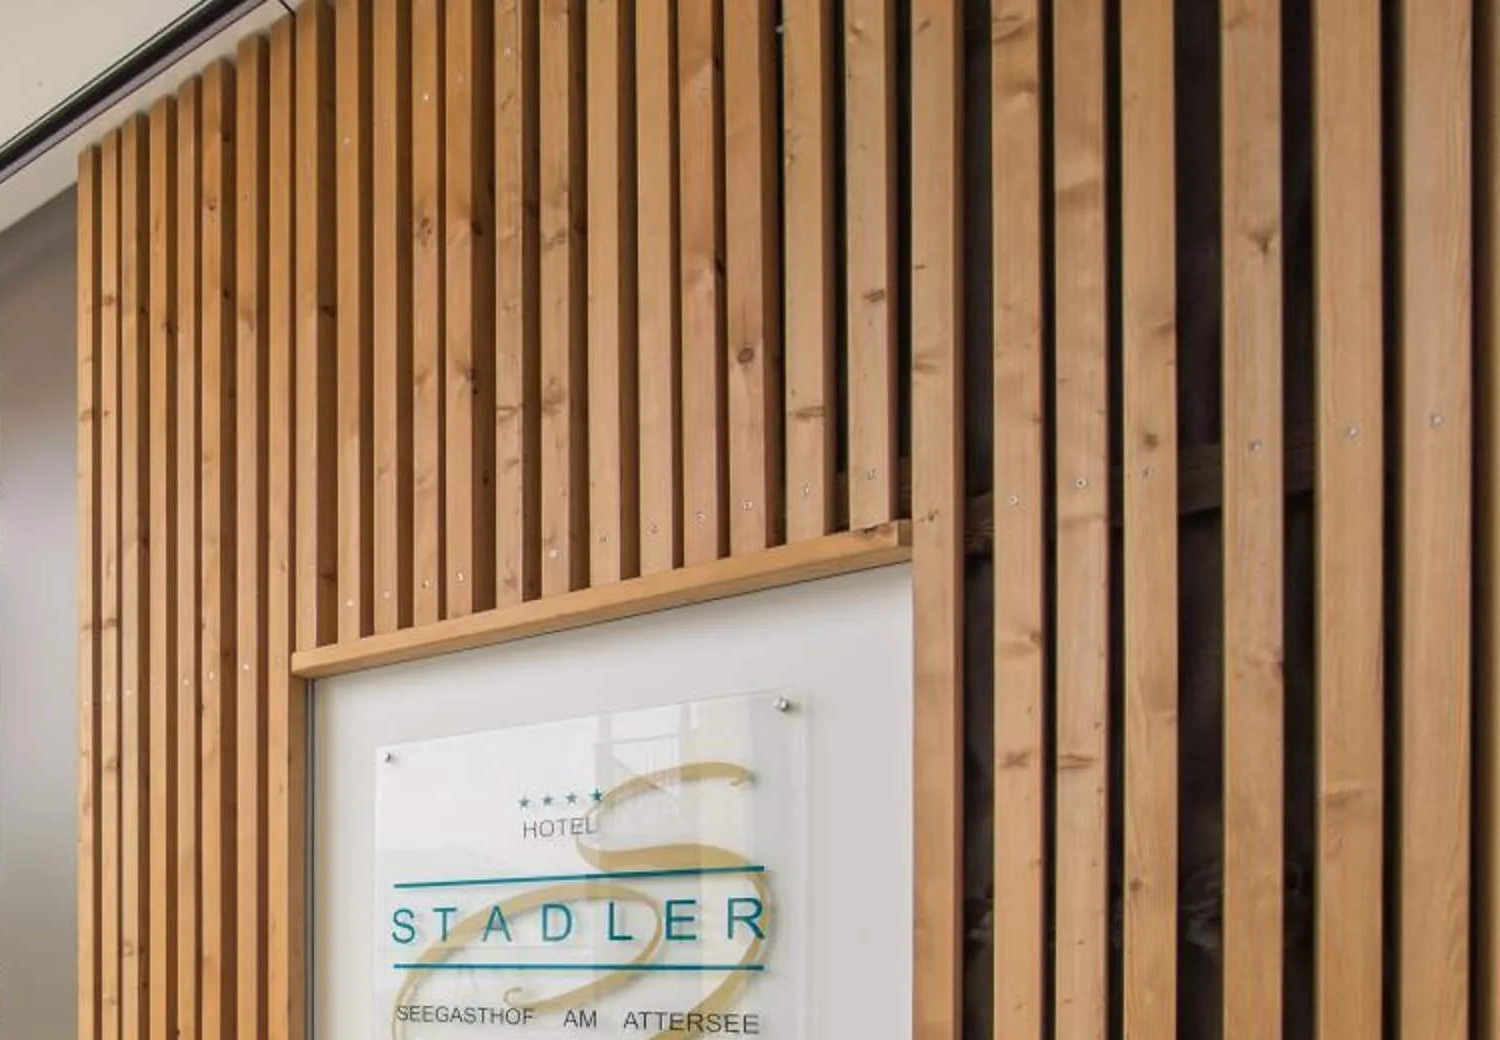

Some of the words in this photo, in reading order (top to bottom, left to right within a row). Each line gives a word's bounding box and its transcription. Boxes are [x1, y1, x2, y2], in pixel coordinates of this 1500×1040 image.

[522, 817, 597, 838] HOTEL
[391, 898, 765, 943] STADLER
[397, 1005, 535, 1025] SEEGASTHOF
[563, 1009, 598, 1029] AM
[623, 1011, 760, 1035] ATTERSEE
